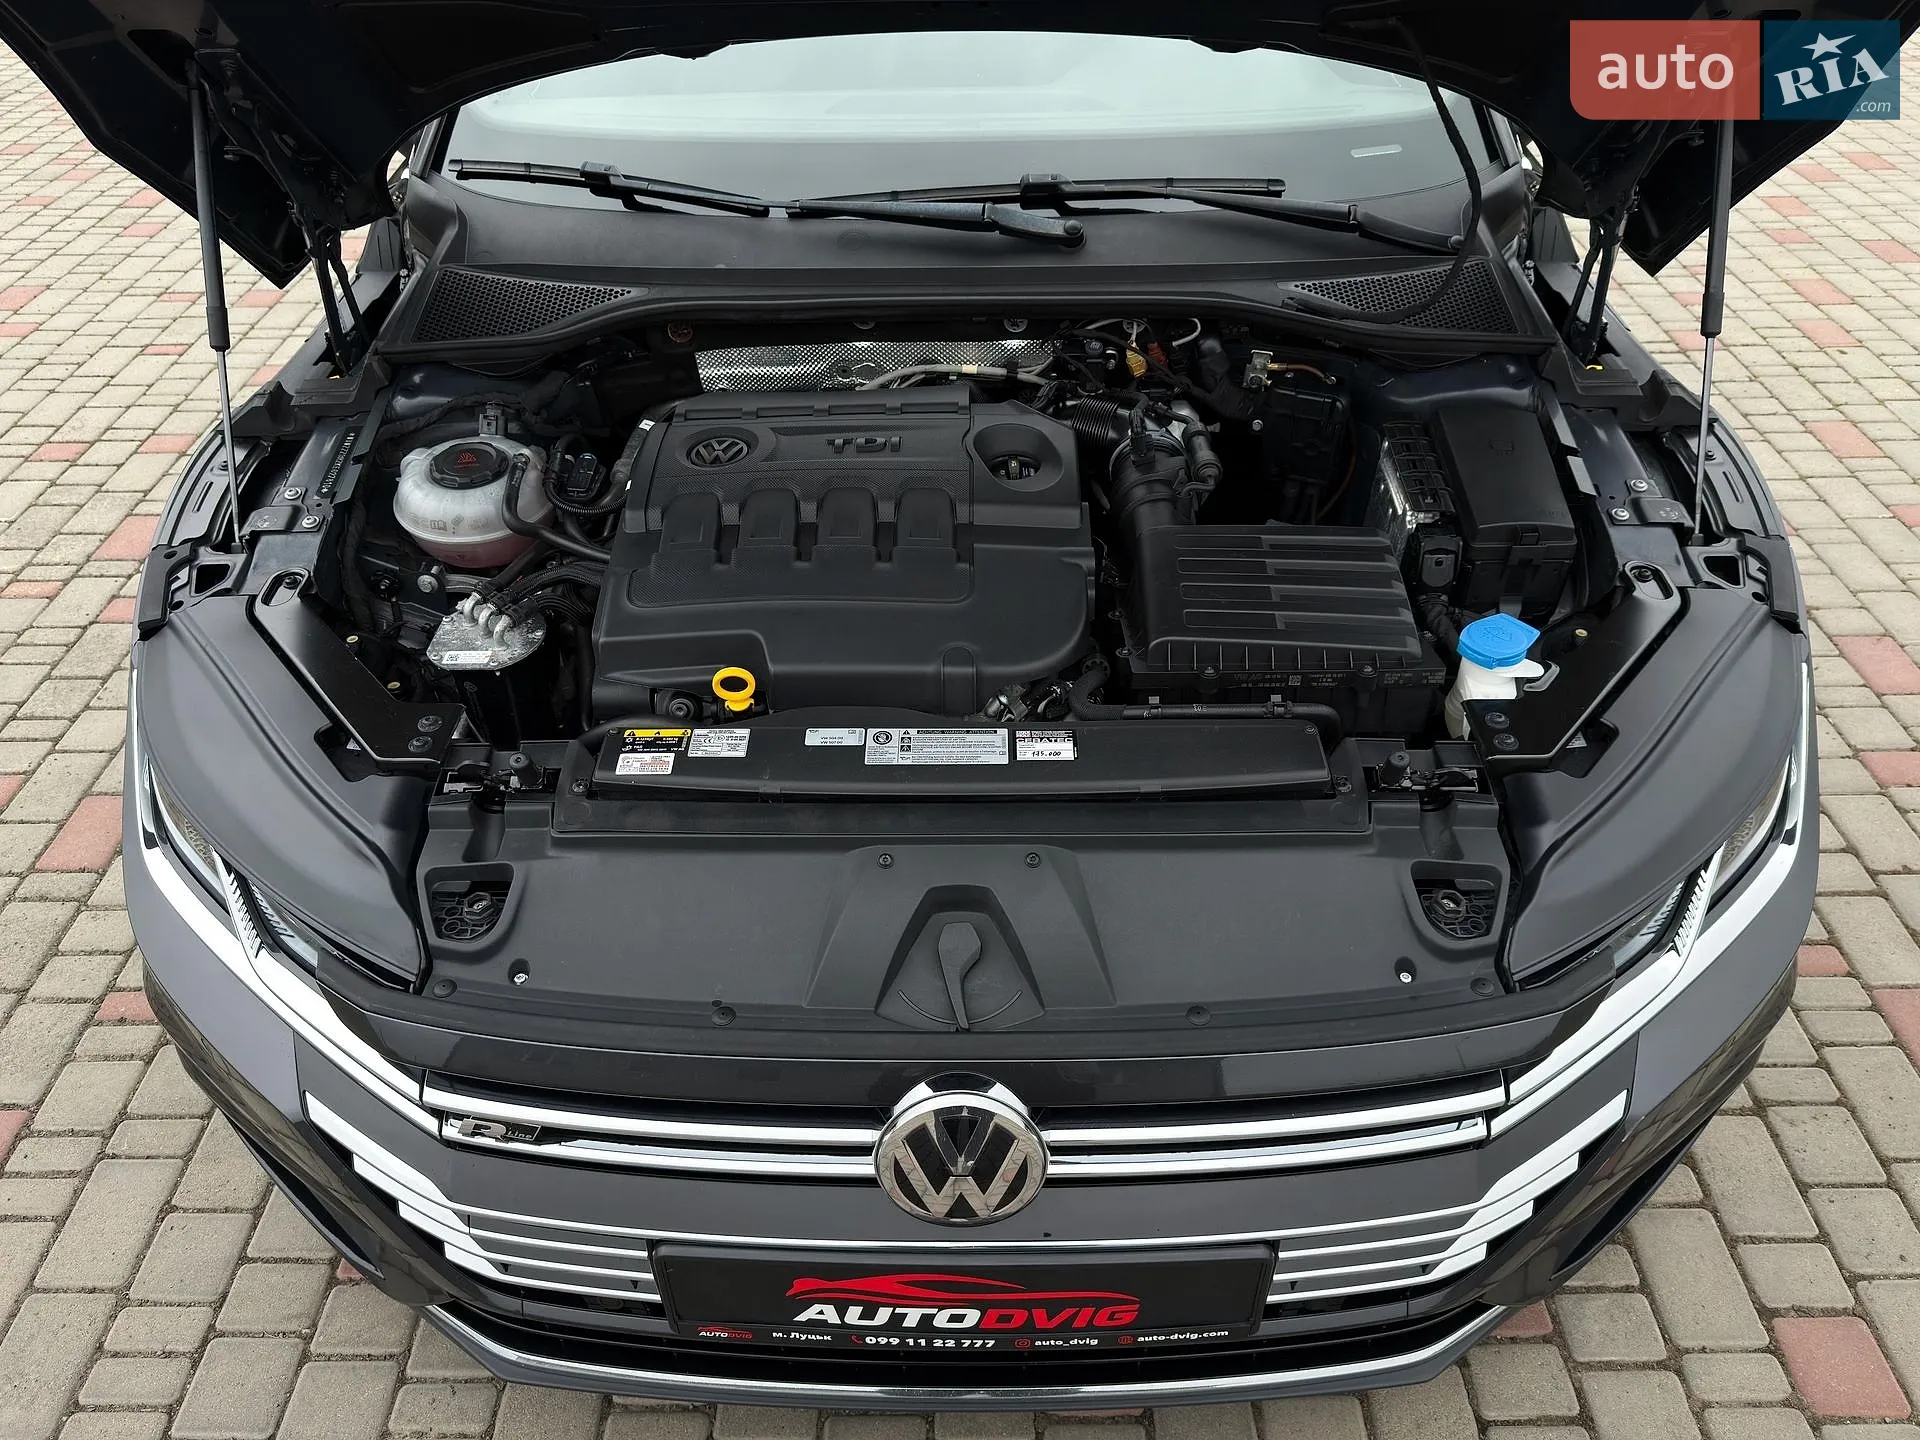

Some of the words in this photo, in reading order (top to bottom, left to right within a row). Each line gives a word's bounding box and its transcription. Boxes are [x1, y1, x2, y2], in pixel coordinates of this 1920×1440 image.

[825, 436, 904, 454] TDI
[790, 1332, 832, 1340] Луцьк
[865, 1336, 900, 1345] 099
[906, 1338, 926, 1346] 11
[933, 1339, 956, 1347] 22
[1137, 1330, 1229, 1342] auto-dvig.com
[1034, 1338, 1098, 1346] auto_dvig
